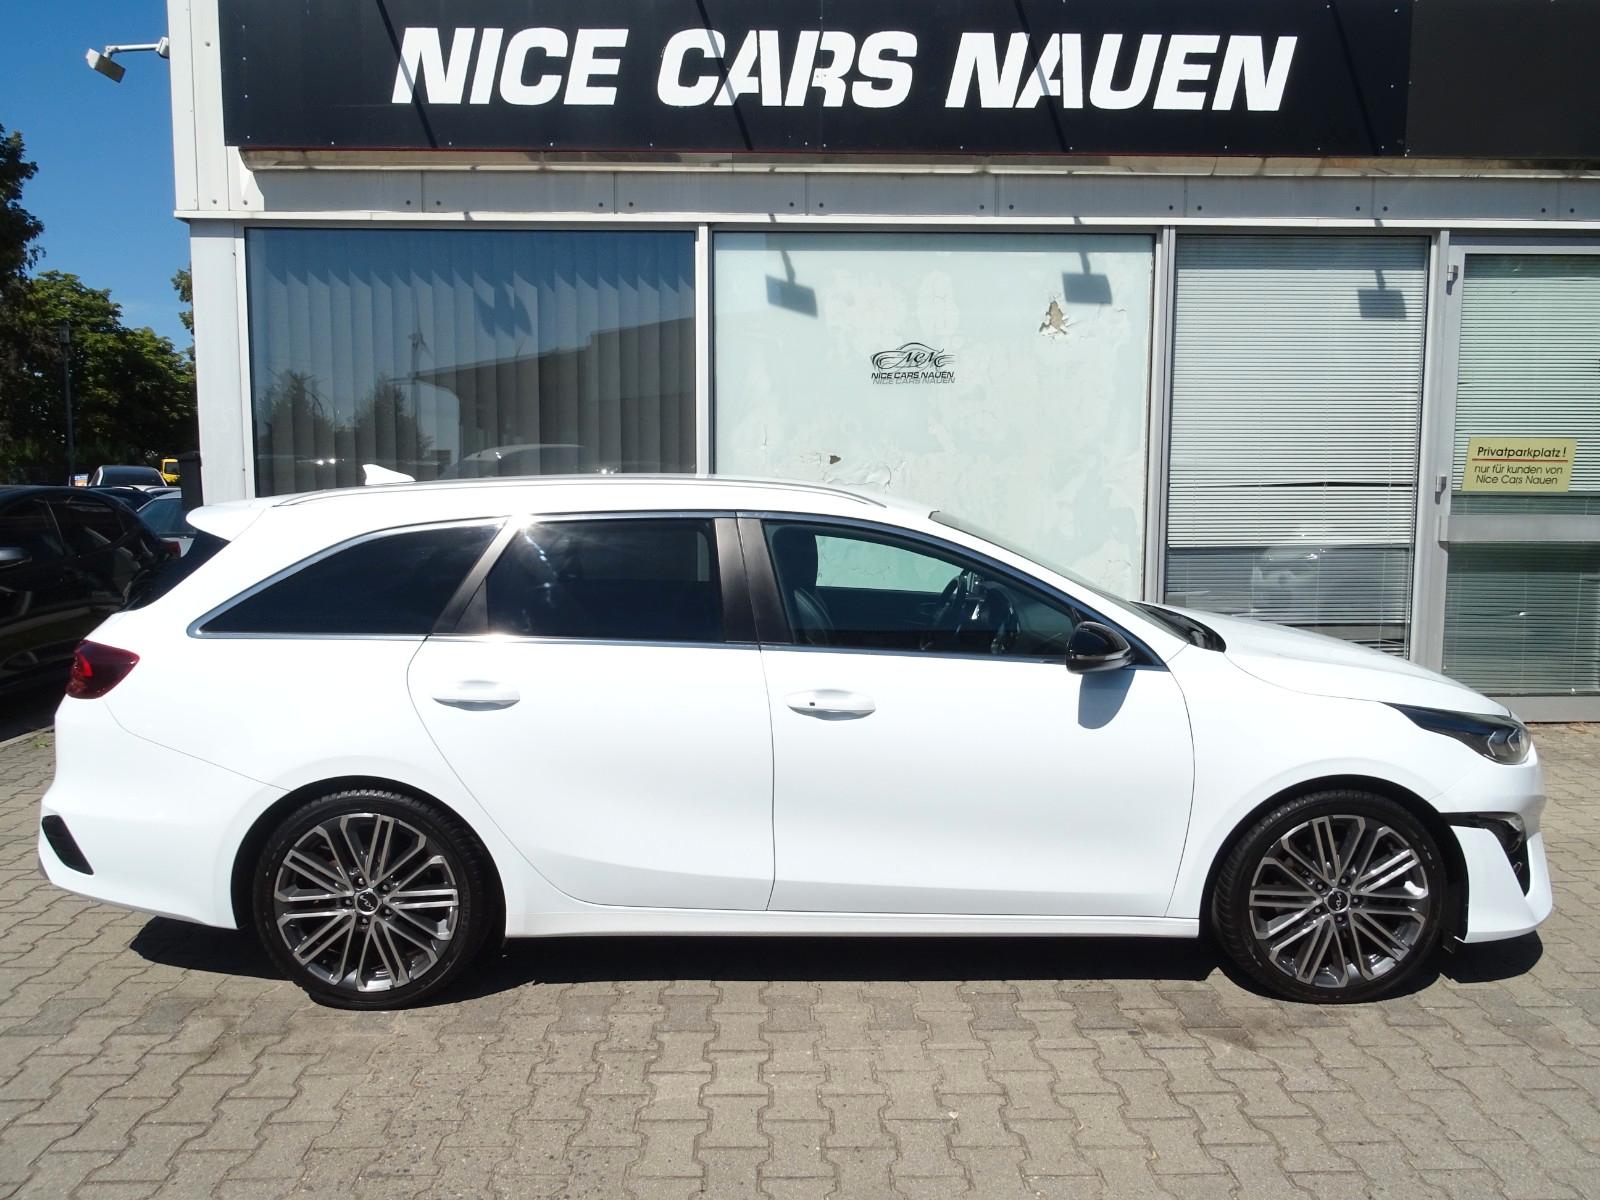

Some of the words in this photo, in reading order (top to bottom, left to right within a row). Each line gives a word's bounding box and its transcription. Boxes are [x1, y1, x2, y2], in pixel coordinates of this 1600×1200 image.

[392, 27, 628, 106] NICE
[657, 28, 918, 109] CARS
[944, 31, 1298, 112] NAUEN
[871, 371, 893, 379] NICE
[894, 371, 919, 379] CARS
[920, 371, 955, 379] NAUEN
[1474, 464, 1490, 473] nur
[1492, 463, 1504, 473] für
[1506, 464, 1543, 474] kunden
[1545, 466, 1563, 474] von
[1475, 474, 1499, 484] Nice
[1500, 474, 1523, 484] Cars
[1525, 475, 1558, 485] Nauen
